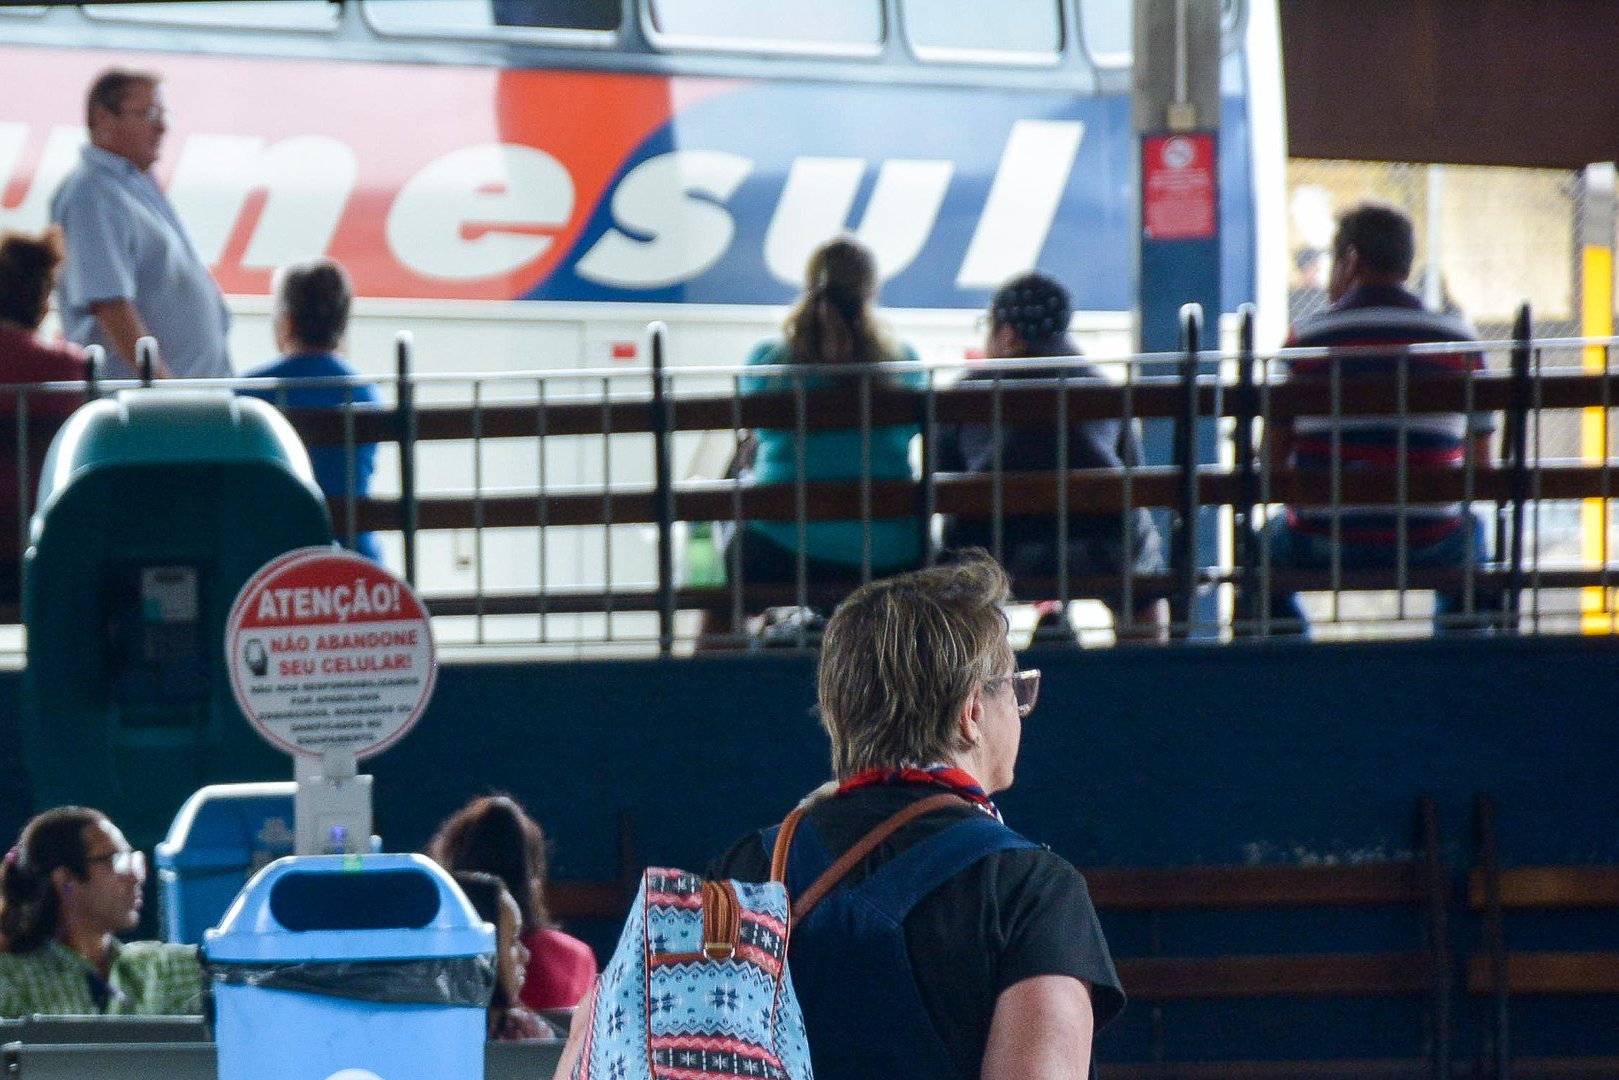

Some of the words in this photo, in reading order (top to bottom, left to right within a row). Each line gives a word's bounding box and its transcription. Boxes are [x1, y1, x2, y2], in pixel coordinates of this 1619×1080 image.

[256, 578, 401, 623] ATENÇÃO!
[269, 631, 310, 653] NÃO
[316, 629, 418, 651] ABANDONE
[280, 659, 315, 676] SEU
[320, 654, 412, 674] CELULAR!
